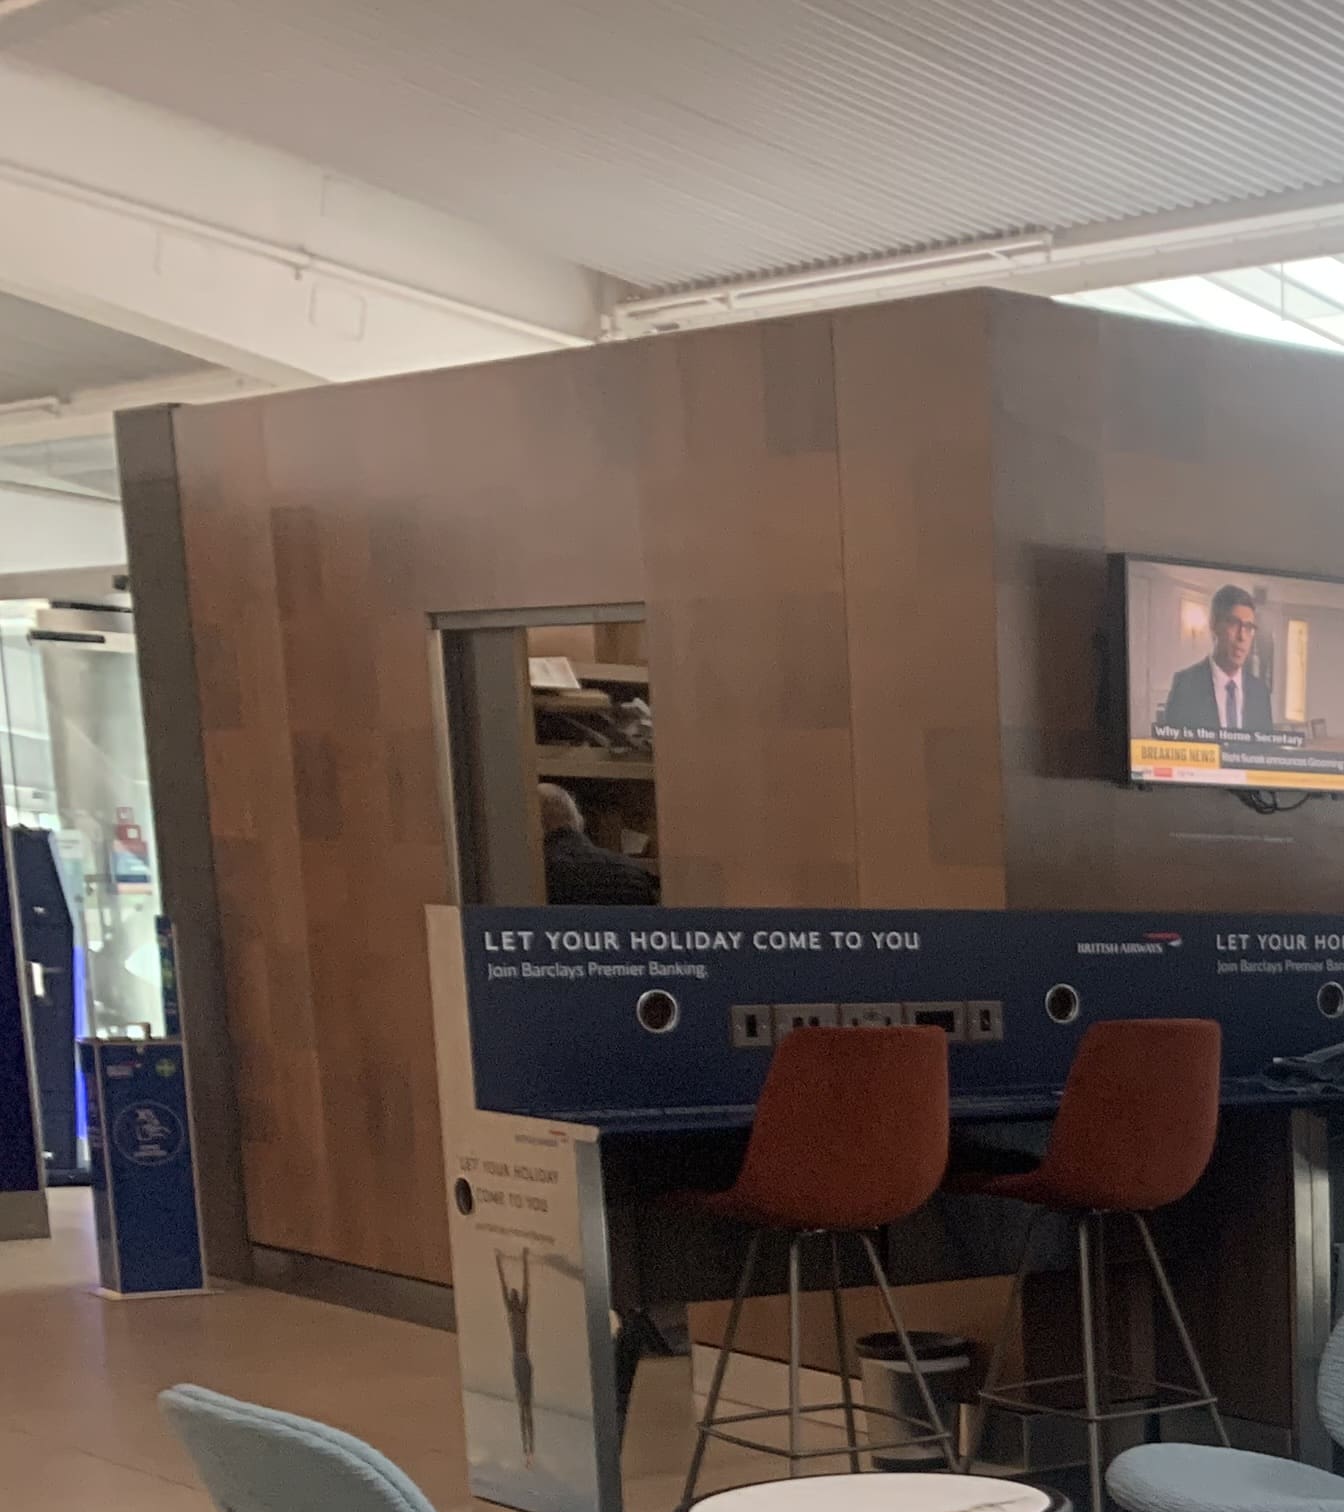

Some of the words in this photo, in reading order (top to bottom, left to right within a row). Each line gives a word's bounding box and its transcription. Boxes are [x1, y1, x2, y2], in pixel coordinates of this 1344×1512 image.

[1183, 727, 1194, 738] is
[1197, 727, 1216, 739] the
[484, 931, 534, 951] LET
[545, 931, 620, 951] YOUR
[630, 931, 743, 950] HOLIDAY
[753, 931, 822, 950] COME
[830, 931, 862, 950] TO
[872, 931, 920, 950] YOU
[1215, 934, 1249, 950] LET
[1257, 934, 1307, 950] YOUR
[488, 962, 517, 980] Join
[521, 962, 584, 980] Barclays
[588, 961, 645, 978] Premier
